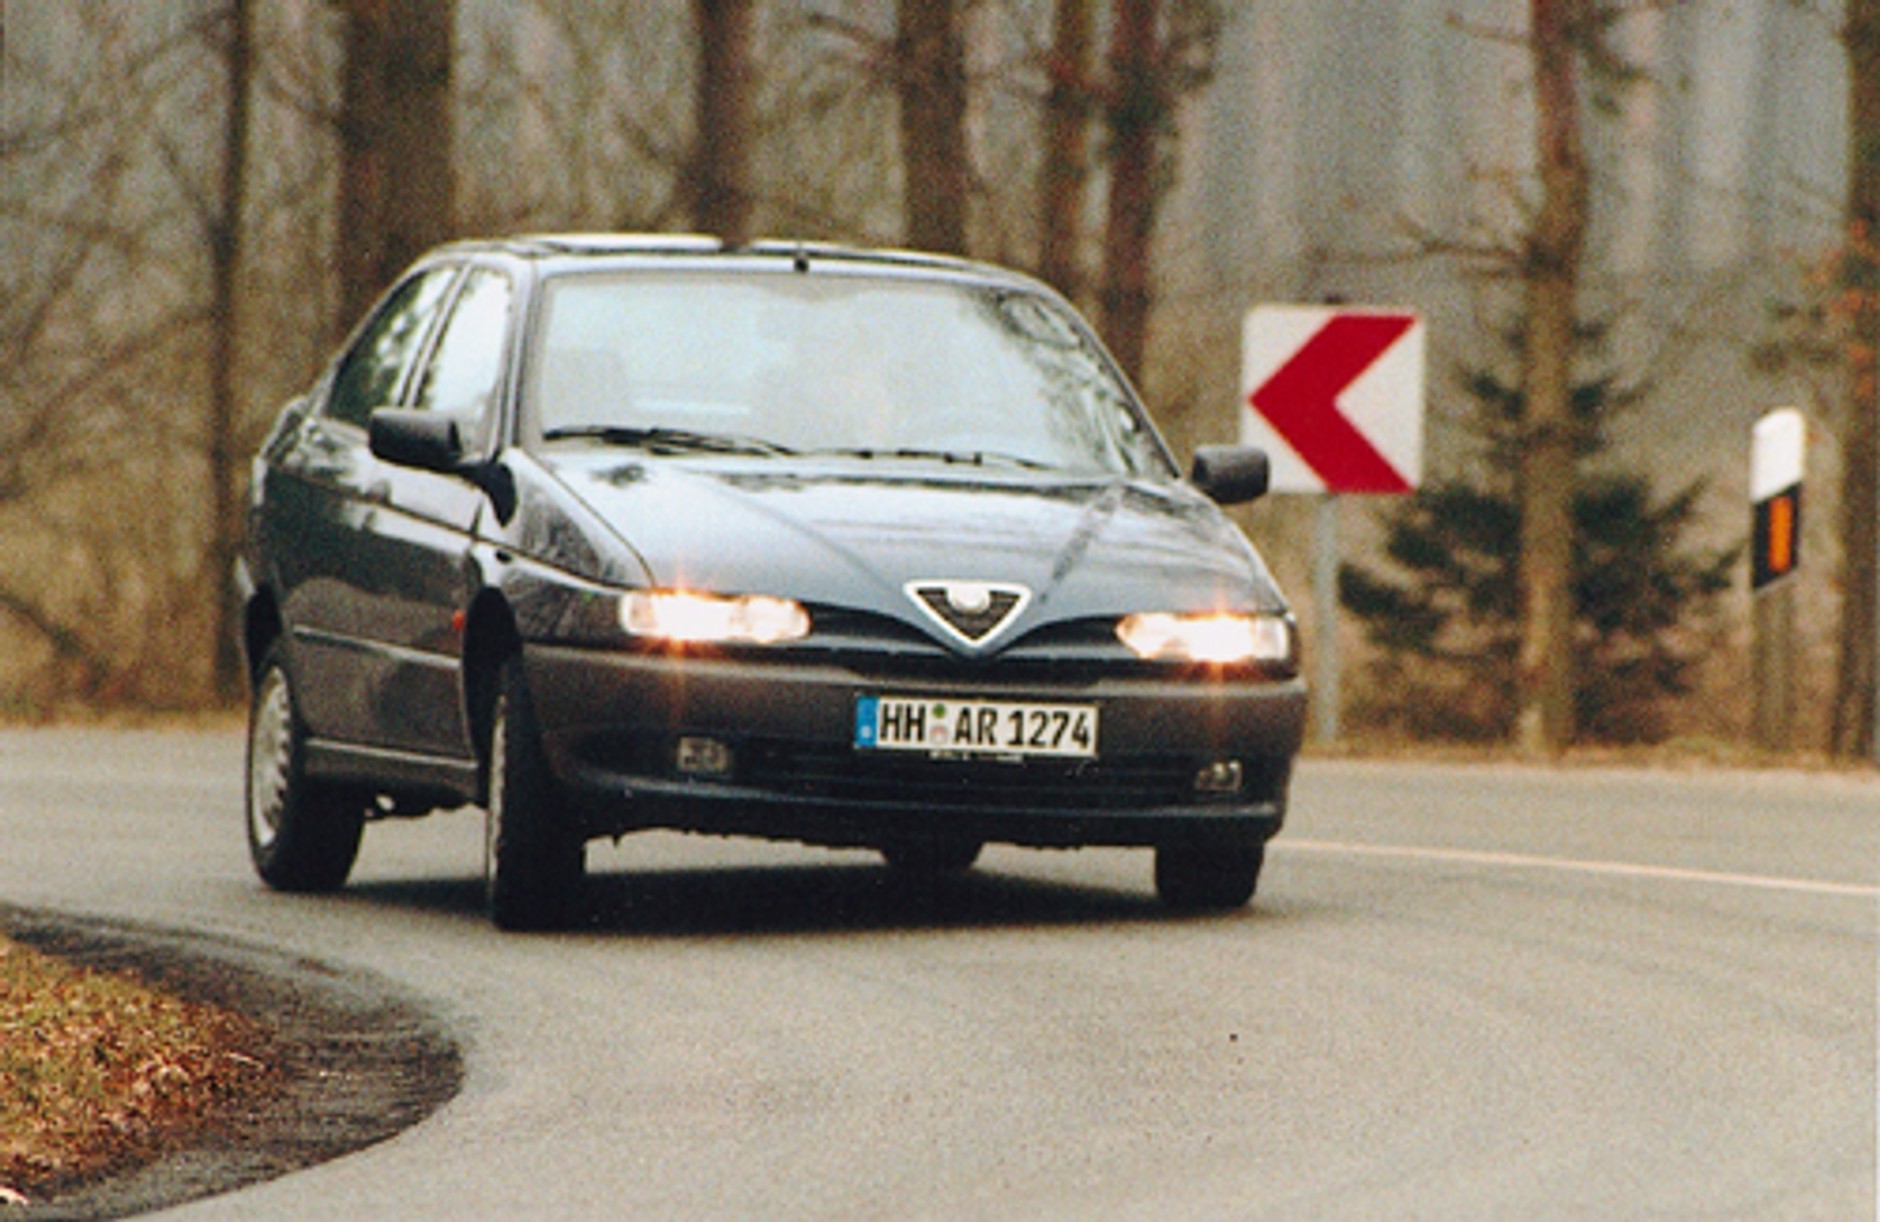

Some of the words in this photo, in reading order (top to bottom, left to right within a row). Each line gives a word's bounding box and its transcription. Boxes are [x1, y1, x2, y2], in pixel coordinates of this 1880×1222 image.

[879, 703, 926, 742] HH
[954, 706, 998, 745] AR
[1007, 710, 1090, 749] 1274
